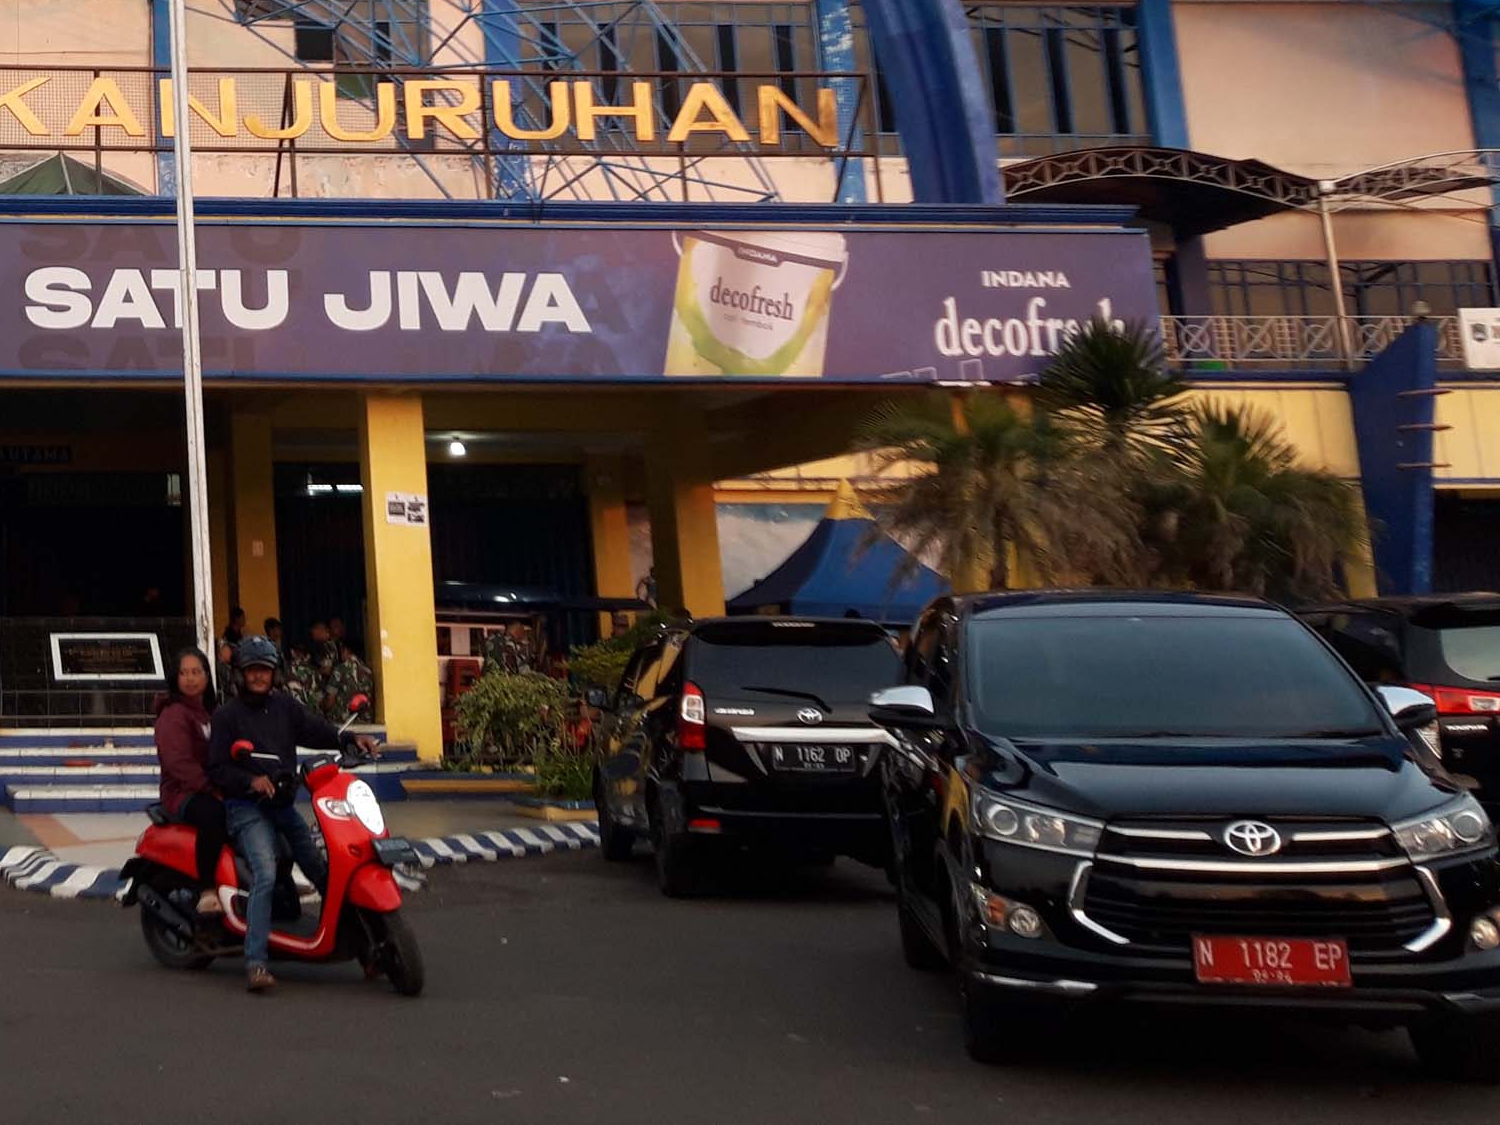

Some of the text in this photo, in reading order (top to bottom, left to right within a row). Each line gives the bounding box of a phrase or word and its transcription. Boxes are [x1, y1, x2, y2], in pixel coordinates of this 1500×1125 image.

[980, 270, 1072, 288] INDANA
[24, 266, 290, 330] SATU
[323, 270, 593, 333] JIWA
[709, 276, 795, 321] decofresh
[934, 296, 1126, 357] decofreh
[7, 445, 71, 461] UTAMA
[773, 746, 785, 762] N
[796, 747, 826, 763] 1162
[1198, 940, 1343, 971] N 1182 EP
